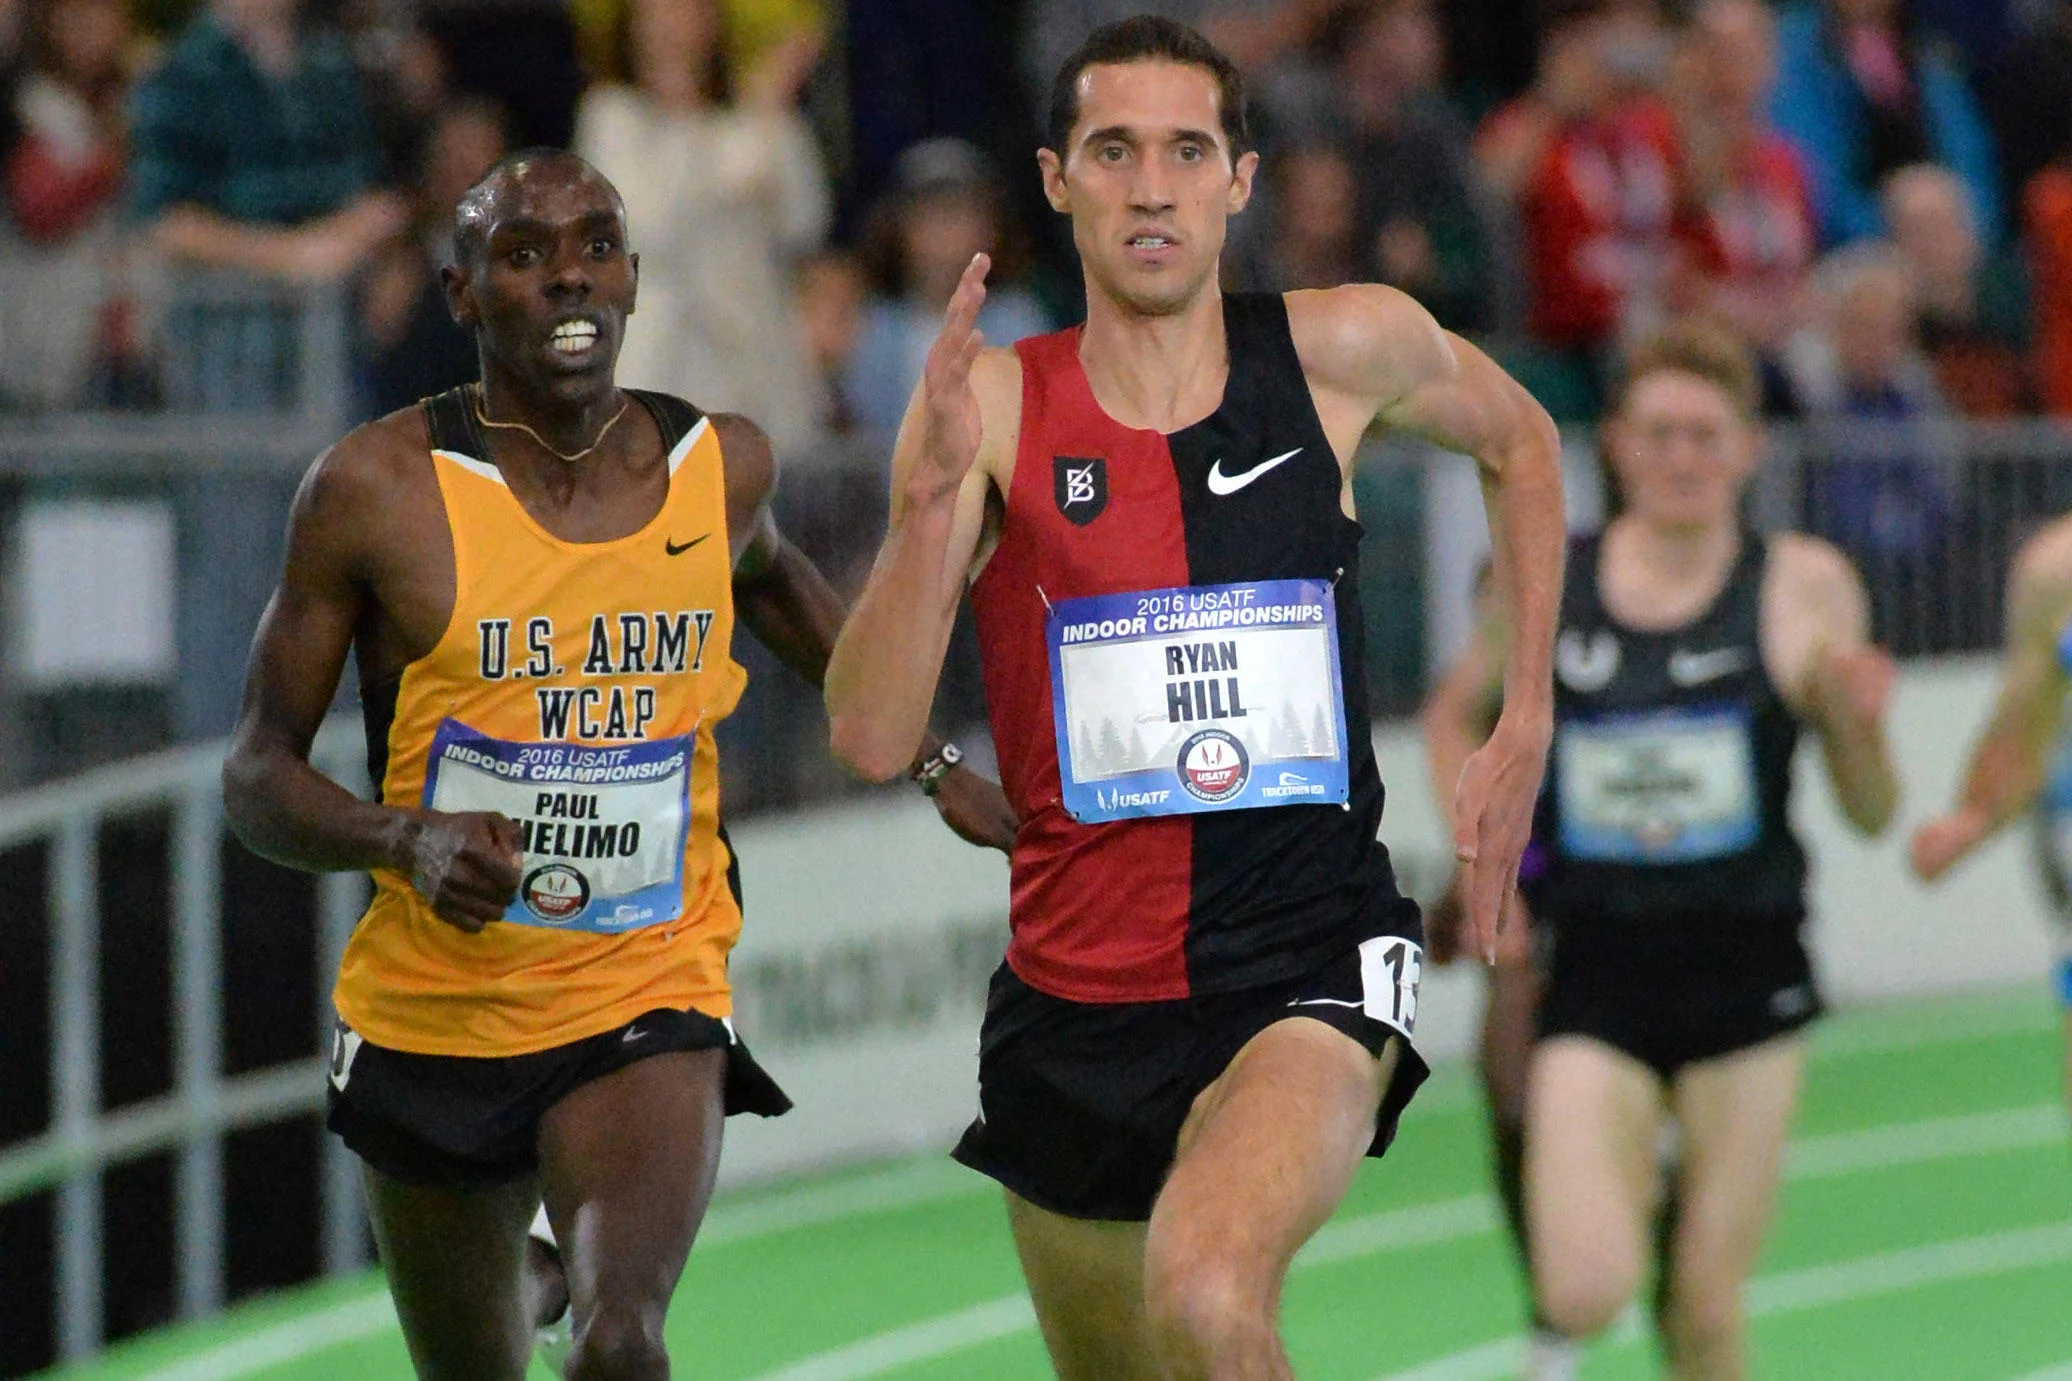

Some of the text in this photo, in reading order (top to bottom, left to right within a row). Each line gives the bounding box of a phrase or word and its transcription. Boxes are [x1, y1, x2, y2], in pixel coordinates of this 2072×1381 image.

[1136, 589, 1256, 616] 2016 USATF
[1062, 605, 1323, 643] INDOOR CHAMPIONSHIPS
[476, 609, 714, 681] U.S. ARMY
[1165, 640, 1238, 675] RYAN
[536, 686, 656, 741] WCAP
[1166, 677, 1247, 723] HILL
[444, 743, 685, 783] INDOOR CHAMPIONSHIPS
[517, 748, 631, 767] 2016 USATF
[535, 793, 600, 820] PAUL
[1119, 790, 1171, 808] USATF
